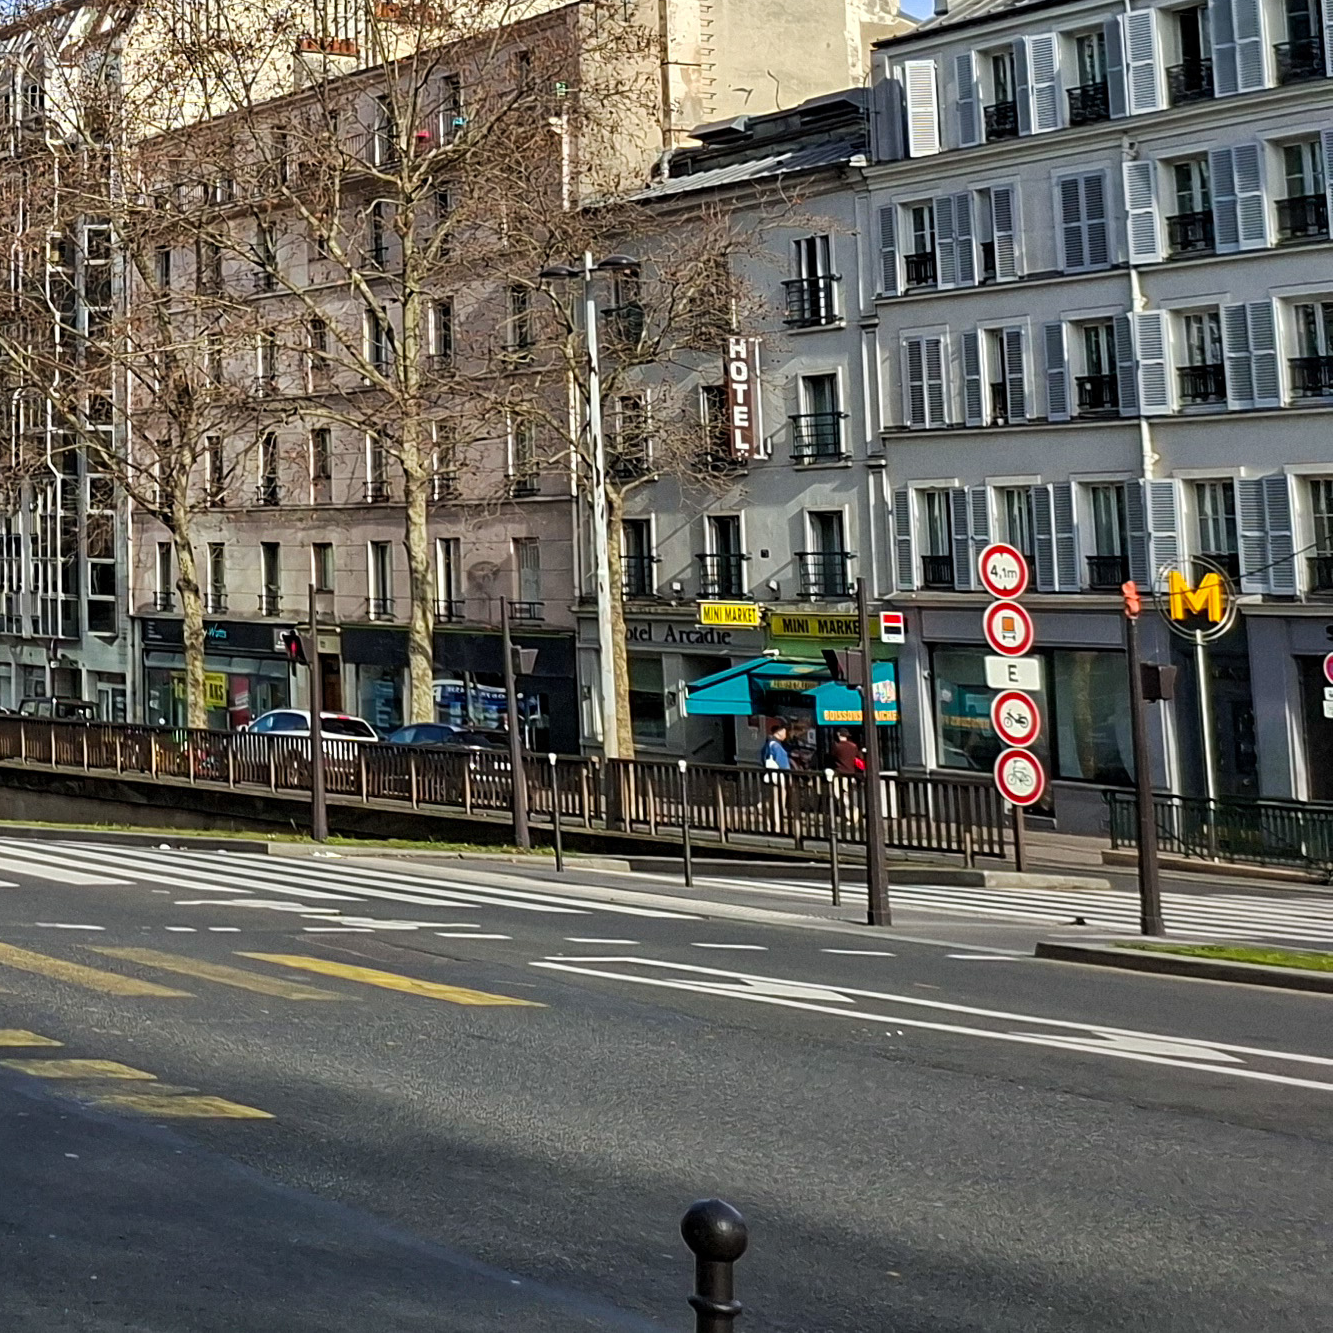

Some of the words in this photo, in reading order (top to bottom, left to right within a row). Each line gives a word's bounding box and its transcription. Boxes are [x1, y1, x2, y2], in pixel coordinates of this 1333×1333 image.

[729, 337, 750, 450] HOTEL
[991, 564, 1018, 579] 4,1m
[1169, 571, 1222, 623] M
[703, 605, 722, 622] MINI
[724, 606, 757, 623] MARKET
[625, 622, 652, 642] otel
[664, 623, 732, 645] Arcadie
[783, 618, 809, 634] MINI
[818, 619, 861, 635] MARKE
[1007, 664, 1019, 682] E
